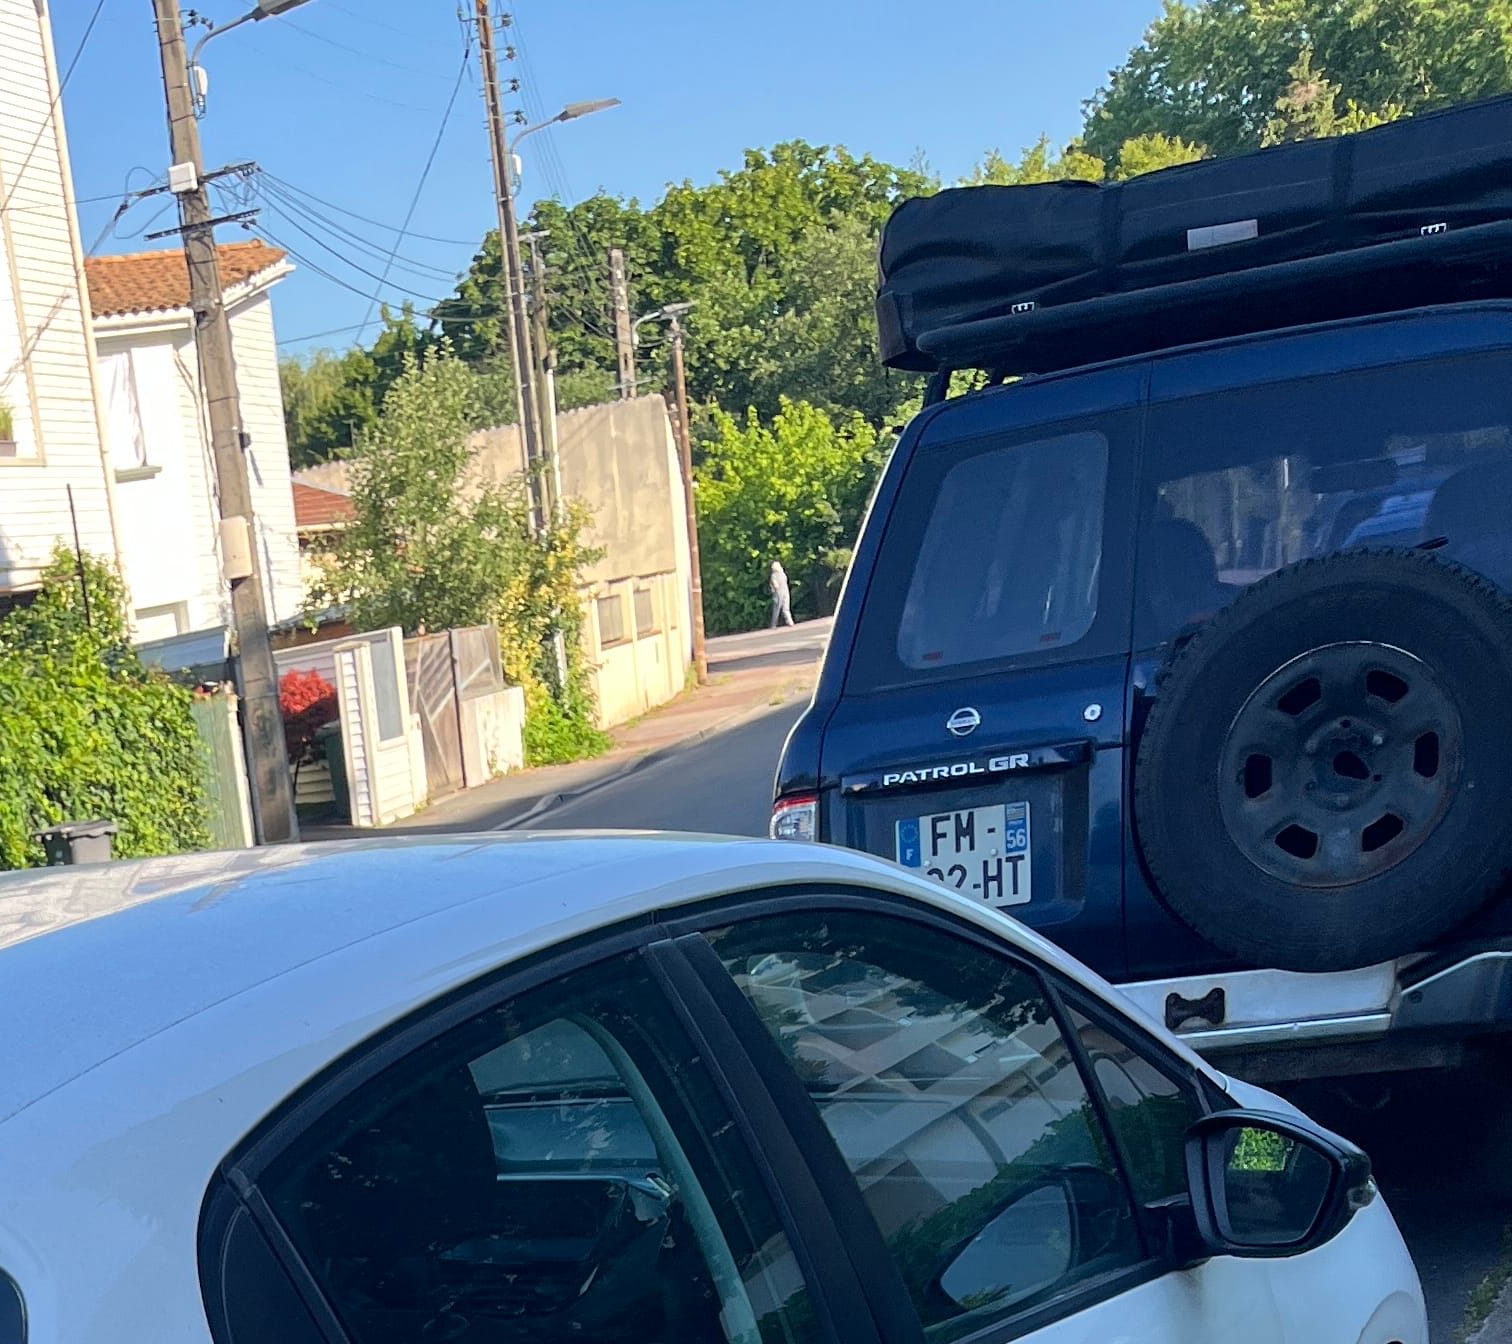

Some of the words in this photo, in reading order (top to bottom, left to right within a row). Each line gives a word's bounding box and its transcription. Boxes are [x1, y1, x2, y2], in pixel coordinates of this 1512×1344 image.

[882, 762, 984, 786] PATROL
[988, 753, 1030, 773] GR
[1006, 829, 1027, 849] 56
[906, 849, 914, 861] F
